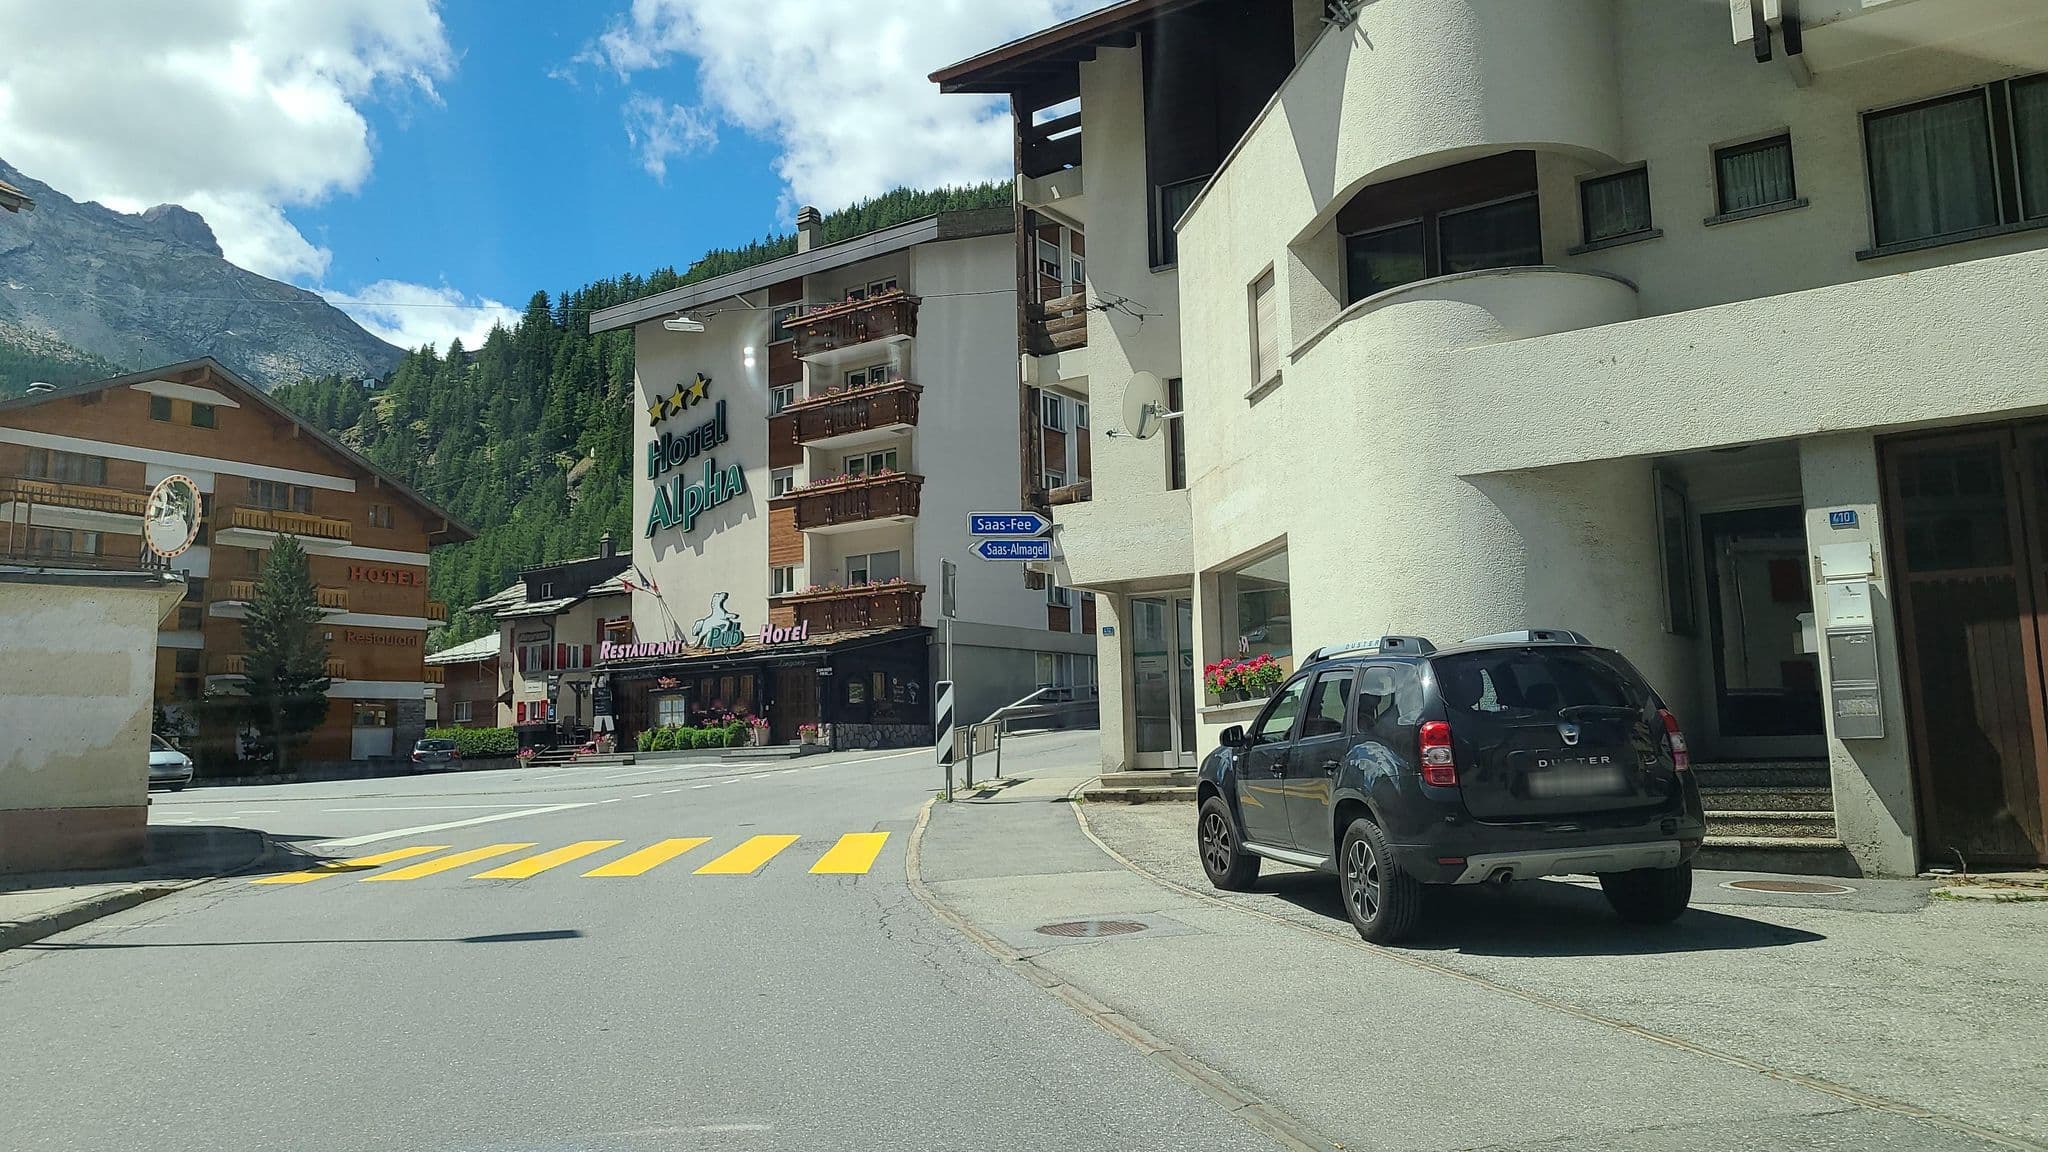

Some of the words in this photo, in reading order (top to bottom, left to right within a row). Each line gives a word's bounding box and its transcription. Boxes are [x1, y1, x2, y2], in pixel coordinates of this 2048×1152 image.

[977, 518, 1032, 531] Saas-Fee
[1832, 511, 1850, 522] 410
[986, 542, 1048, 558] Saas-Almagell
[348, 566, 424, 588] HOTEL
[707, 622, 744, 649] Pub
[600, 639, 685, 660] RESTAURANT
[1344, 639, 1380, 650] DUSTER
